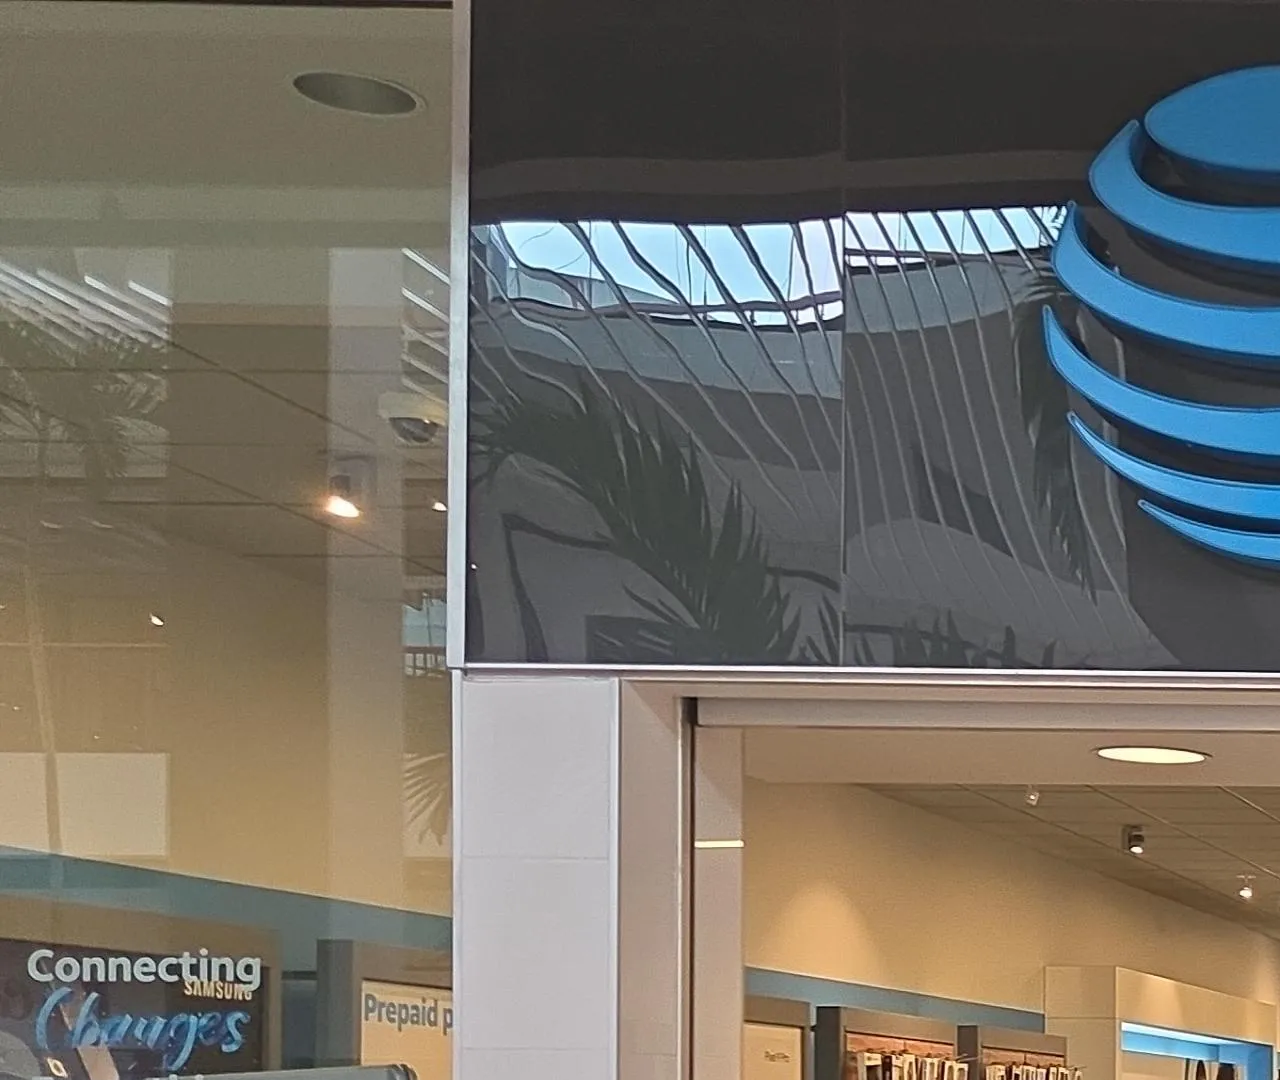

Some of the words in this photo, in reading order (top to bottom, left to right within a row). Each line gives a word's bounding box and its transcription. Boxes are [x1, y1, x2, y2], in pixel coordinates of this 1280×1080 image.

[27, 948, 261, 992] Connecting
[184, 979, 252, 1001] SAMSUNG
[364, 993, 438, 1032] Prepaid
